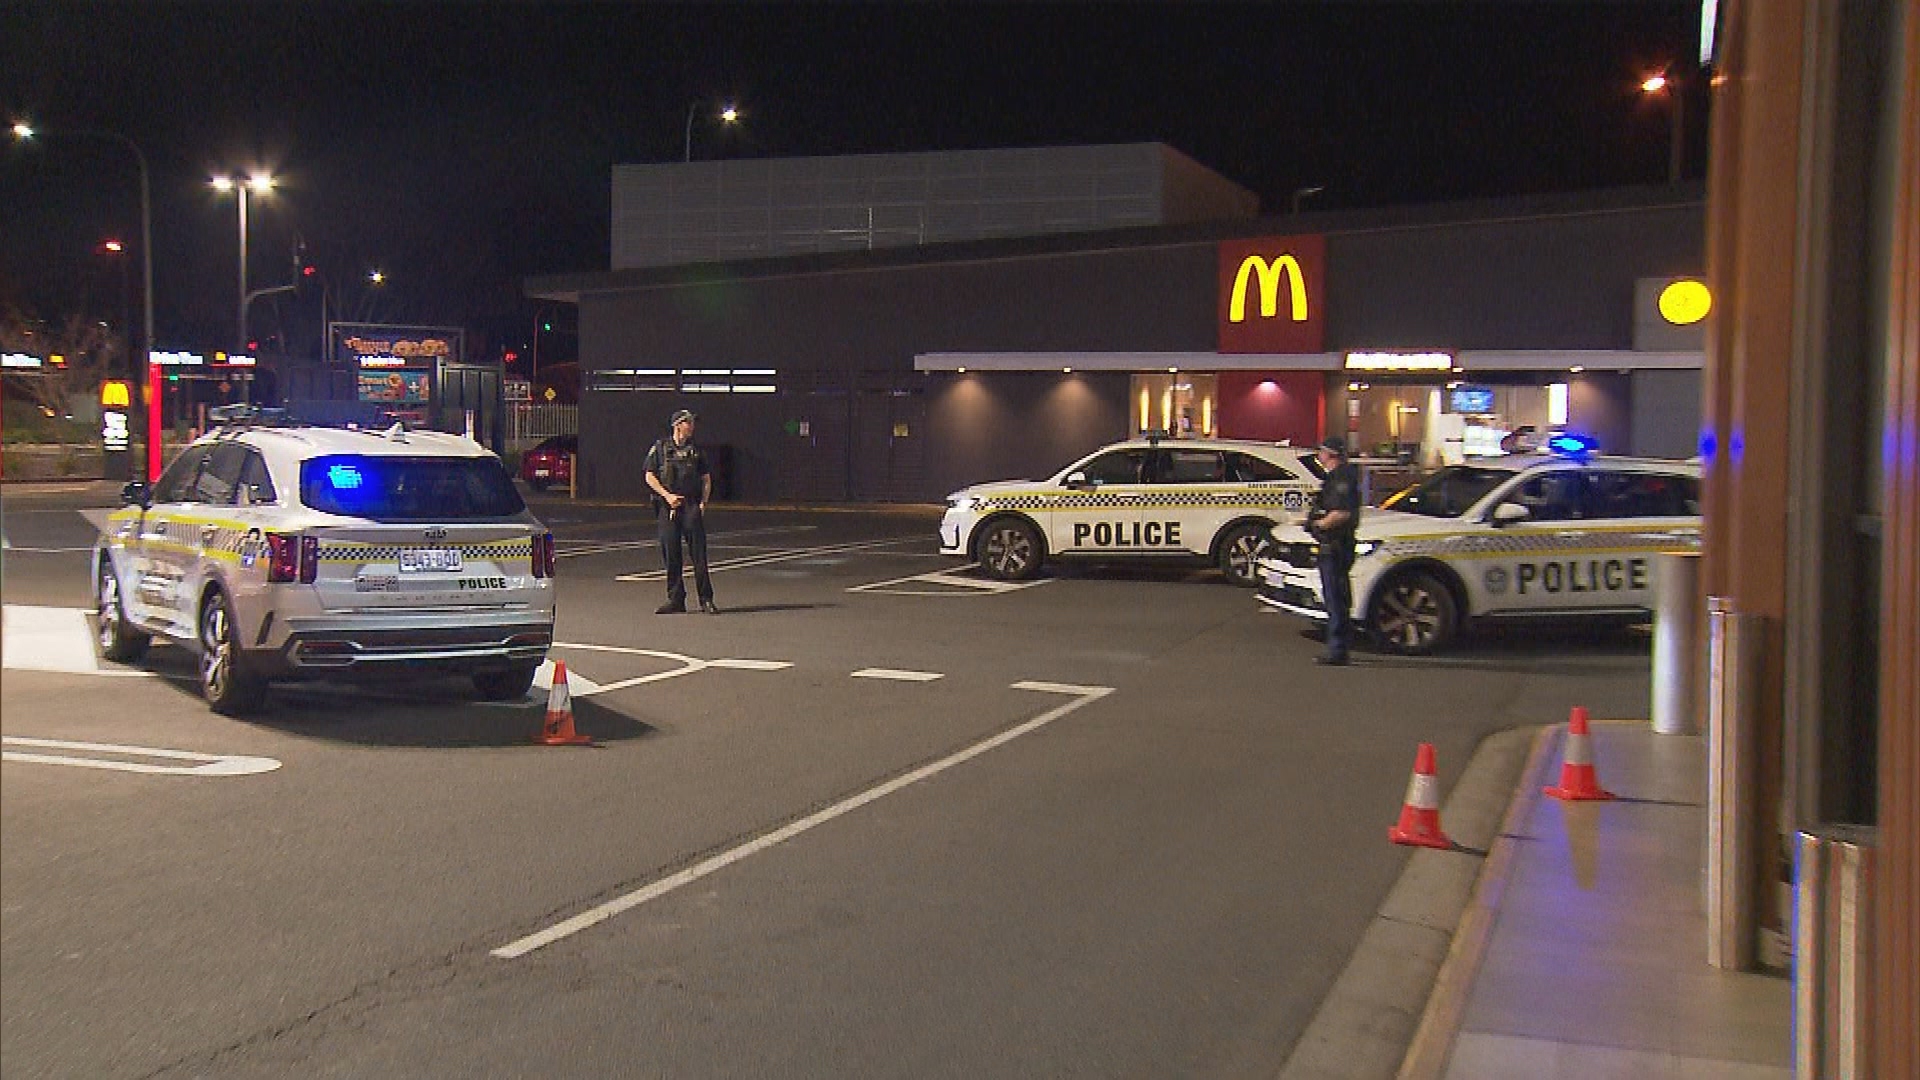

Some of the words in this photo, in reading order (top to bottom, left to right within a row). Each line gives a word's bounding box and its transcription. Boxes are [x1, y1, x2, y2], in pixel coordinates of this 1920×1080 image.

[1073, 521, 1182, 546] POLICE
[458, 577, 507, 590] POLICE
[1517, 558, 1648, 595] POLICE
